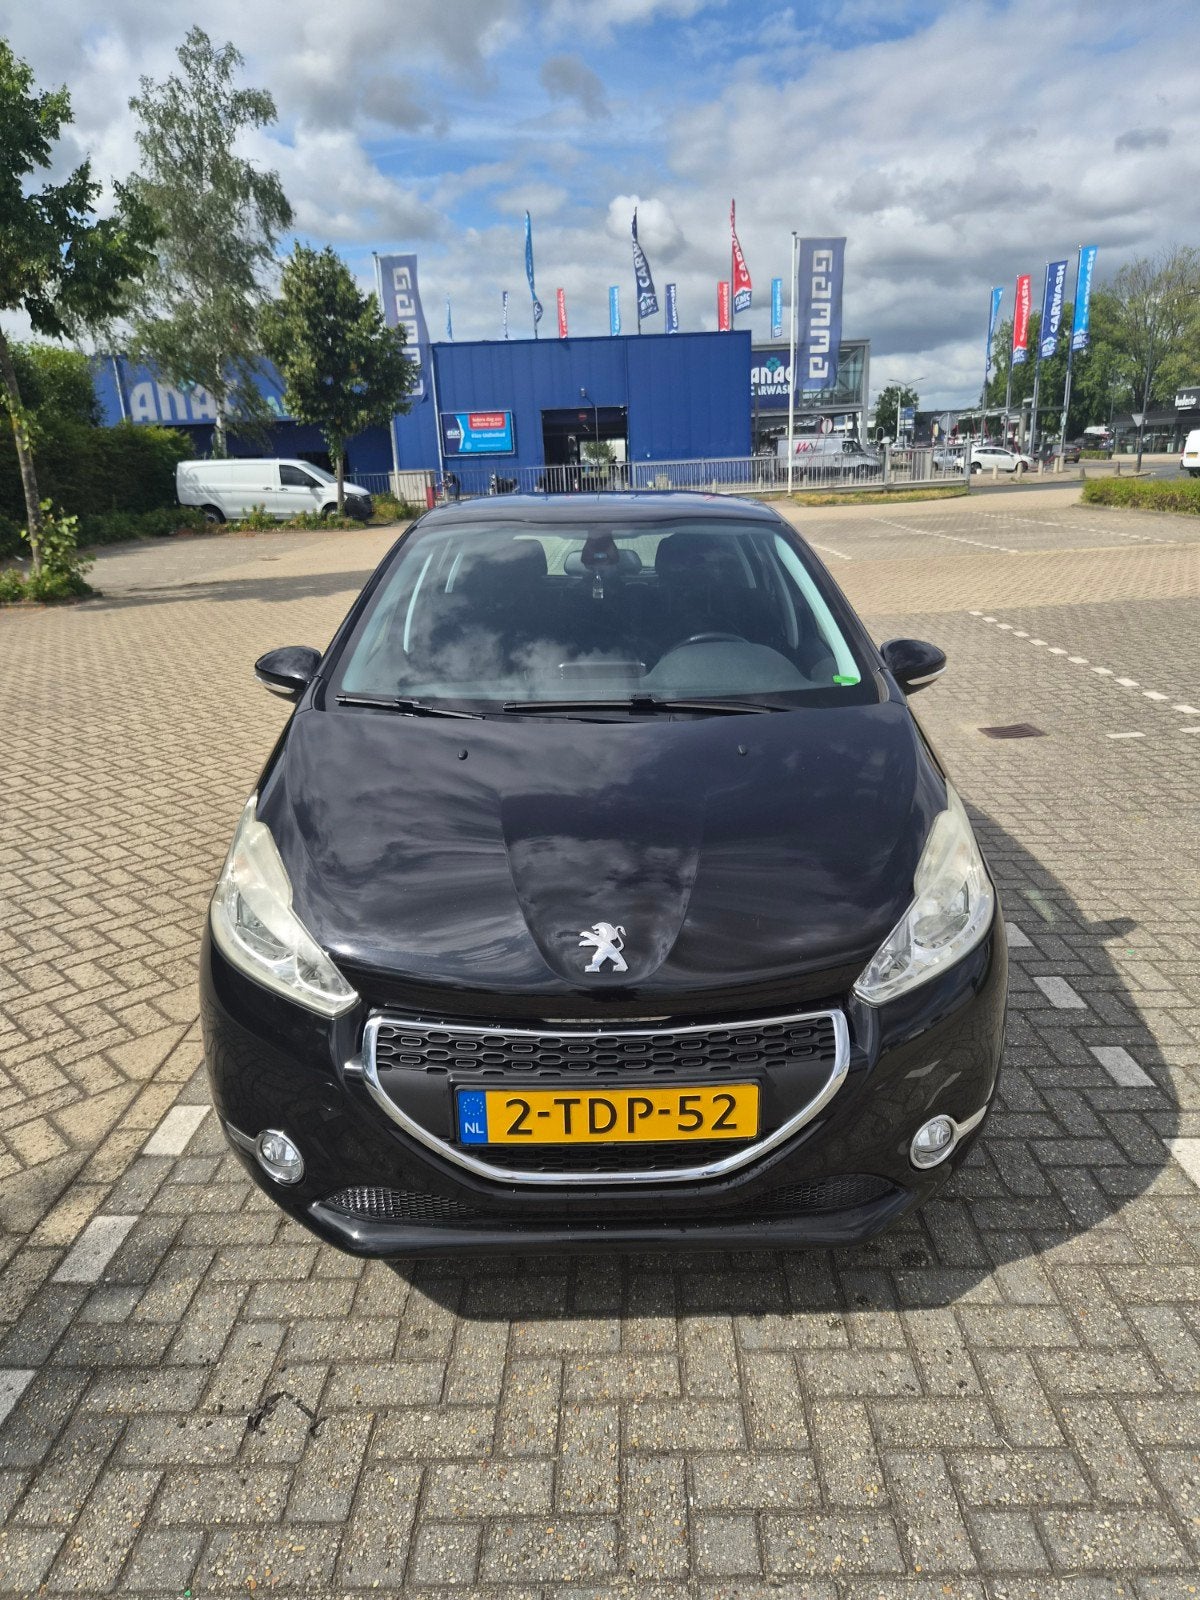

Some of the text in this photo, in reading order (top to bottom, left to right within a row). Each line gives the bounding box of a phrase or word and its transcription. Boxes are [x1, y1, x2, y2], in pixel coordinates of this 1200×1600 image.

[670, 285, 679, 328] CARWASH
[1050, 264, 1066, 334] CARWASH
[464, 1122, 484, 1134] NL
[505, 1093, 738, 1136] 2-TDP-52
